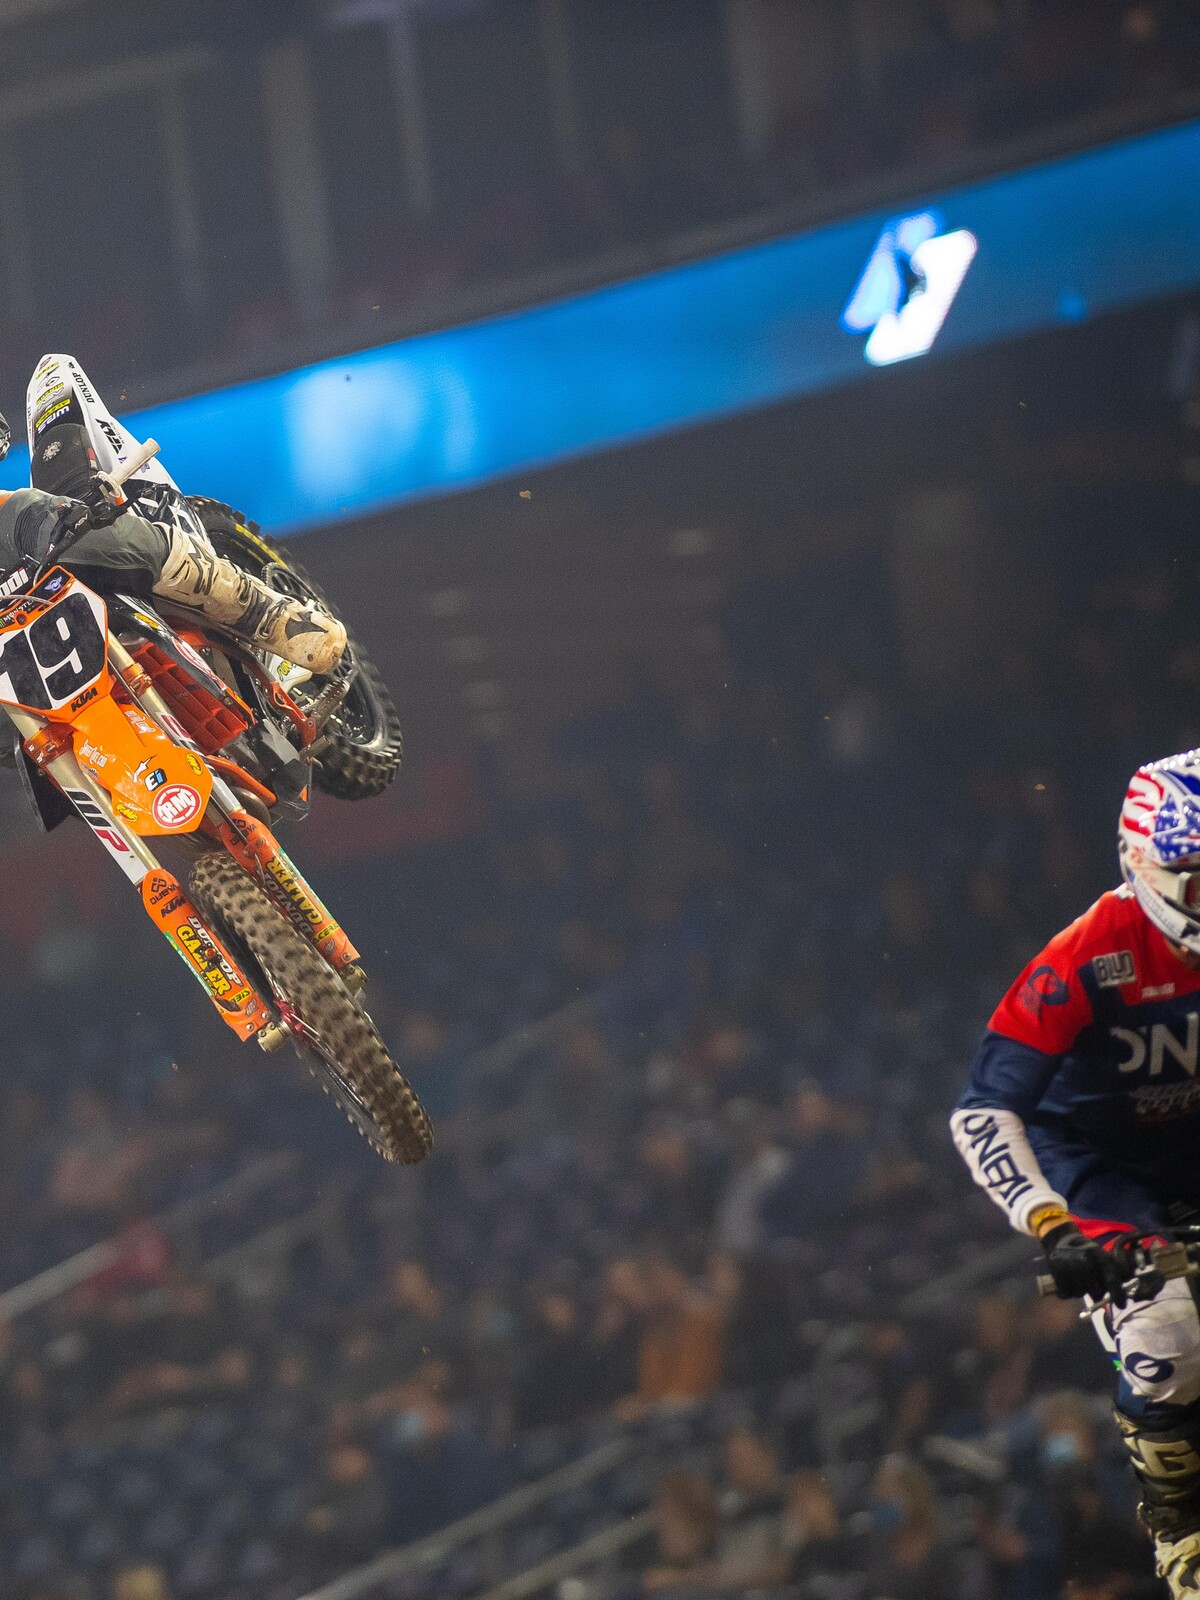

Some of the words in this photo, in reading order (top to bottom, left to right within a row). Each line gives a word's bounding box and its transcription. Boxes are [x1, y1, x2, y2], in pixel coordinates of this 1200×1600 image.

[71, 371, 96, 404] DUNLOP
[70, 687, 99, 713] KTM
[161, 789, 197, 825] RM
[266, 856, 324, 924] GALFER
[160, 895, 187, 919] KTM
